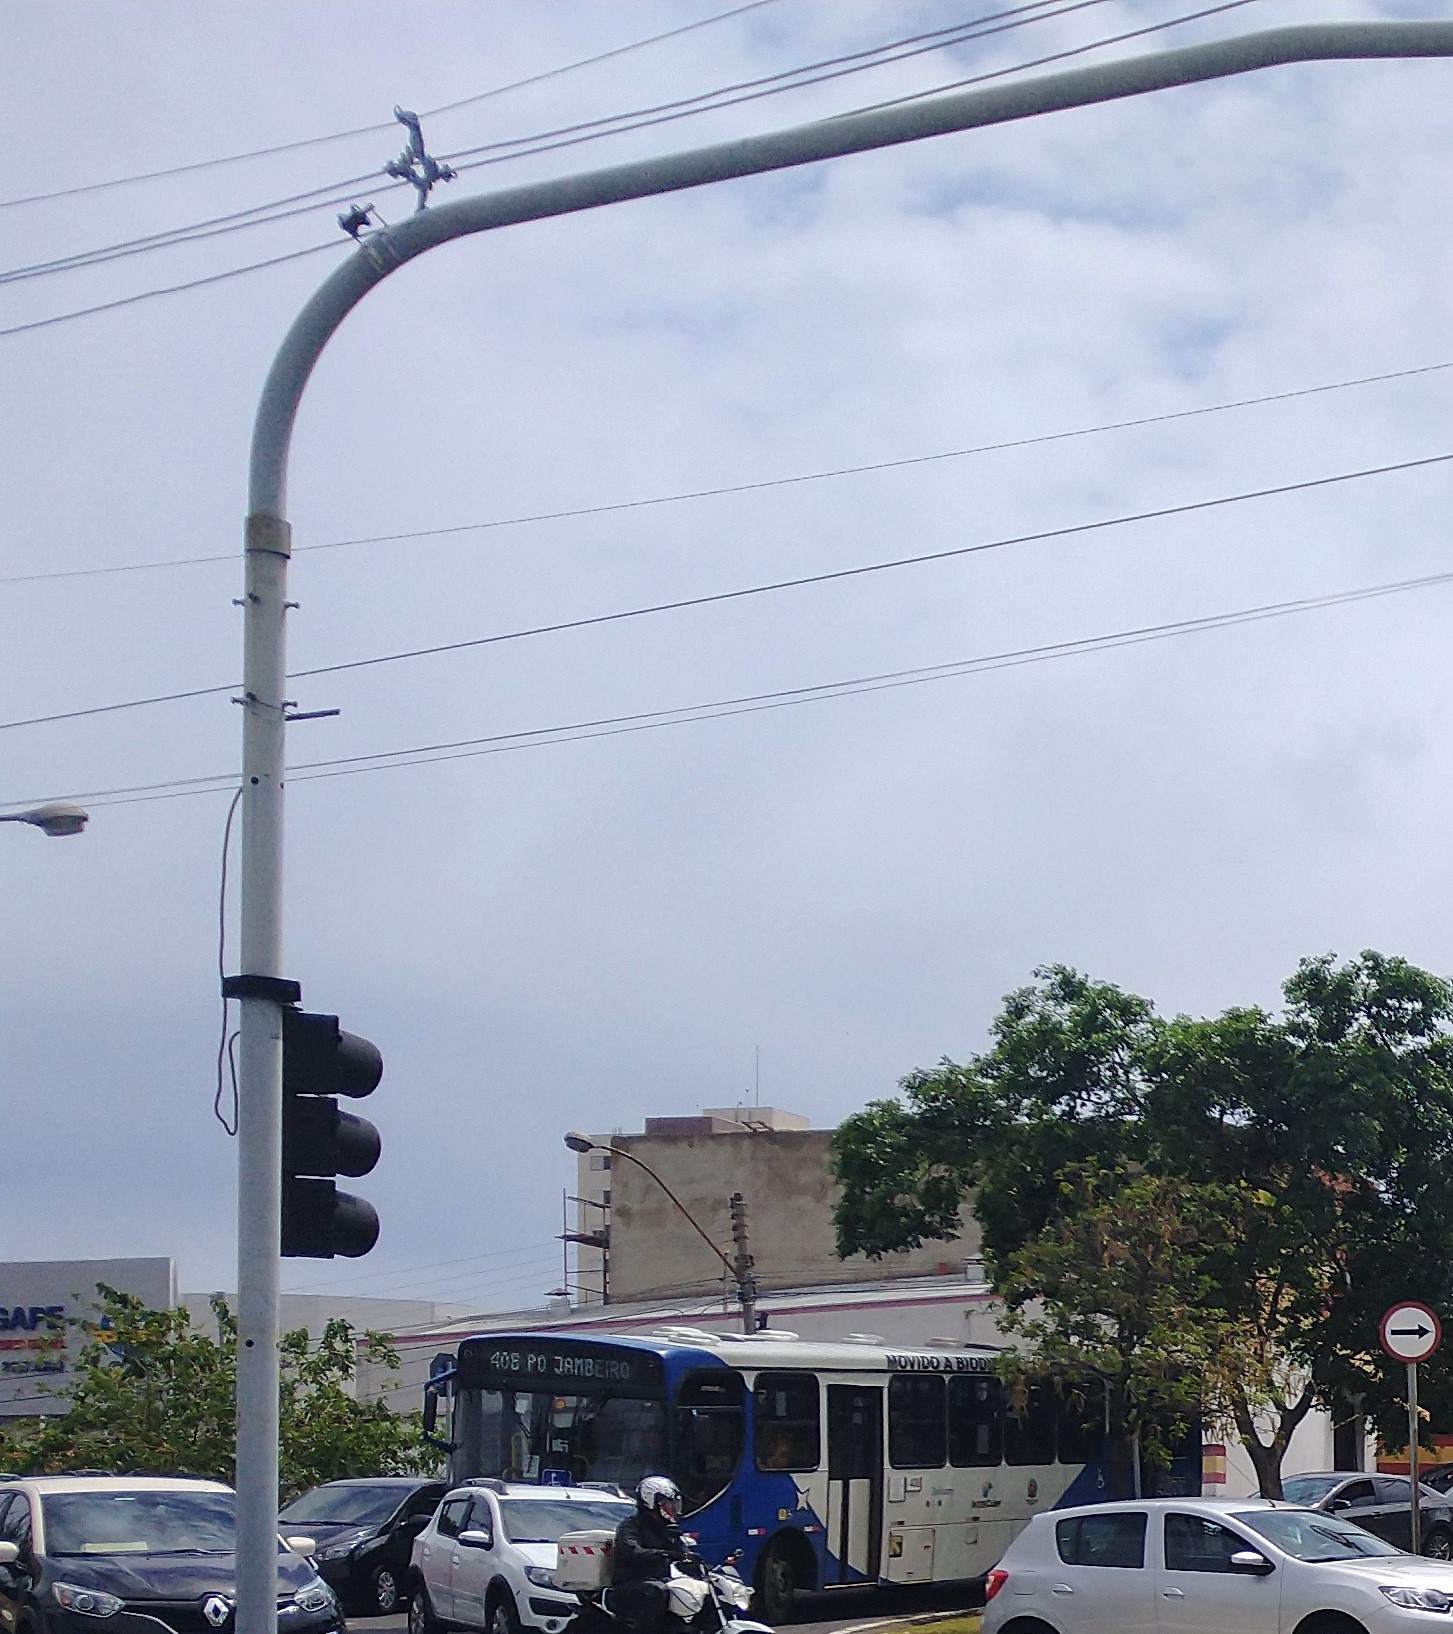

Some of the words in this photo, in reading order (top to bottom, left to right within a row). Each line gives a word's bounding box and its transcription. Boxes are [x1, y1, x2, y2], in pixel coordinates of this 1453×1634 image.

[554, 1356, 630, 1379] JAMBEIRO
[886, 1354, 939, 1370] MOVIDO
[943, 1357, 952, 1370] A
